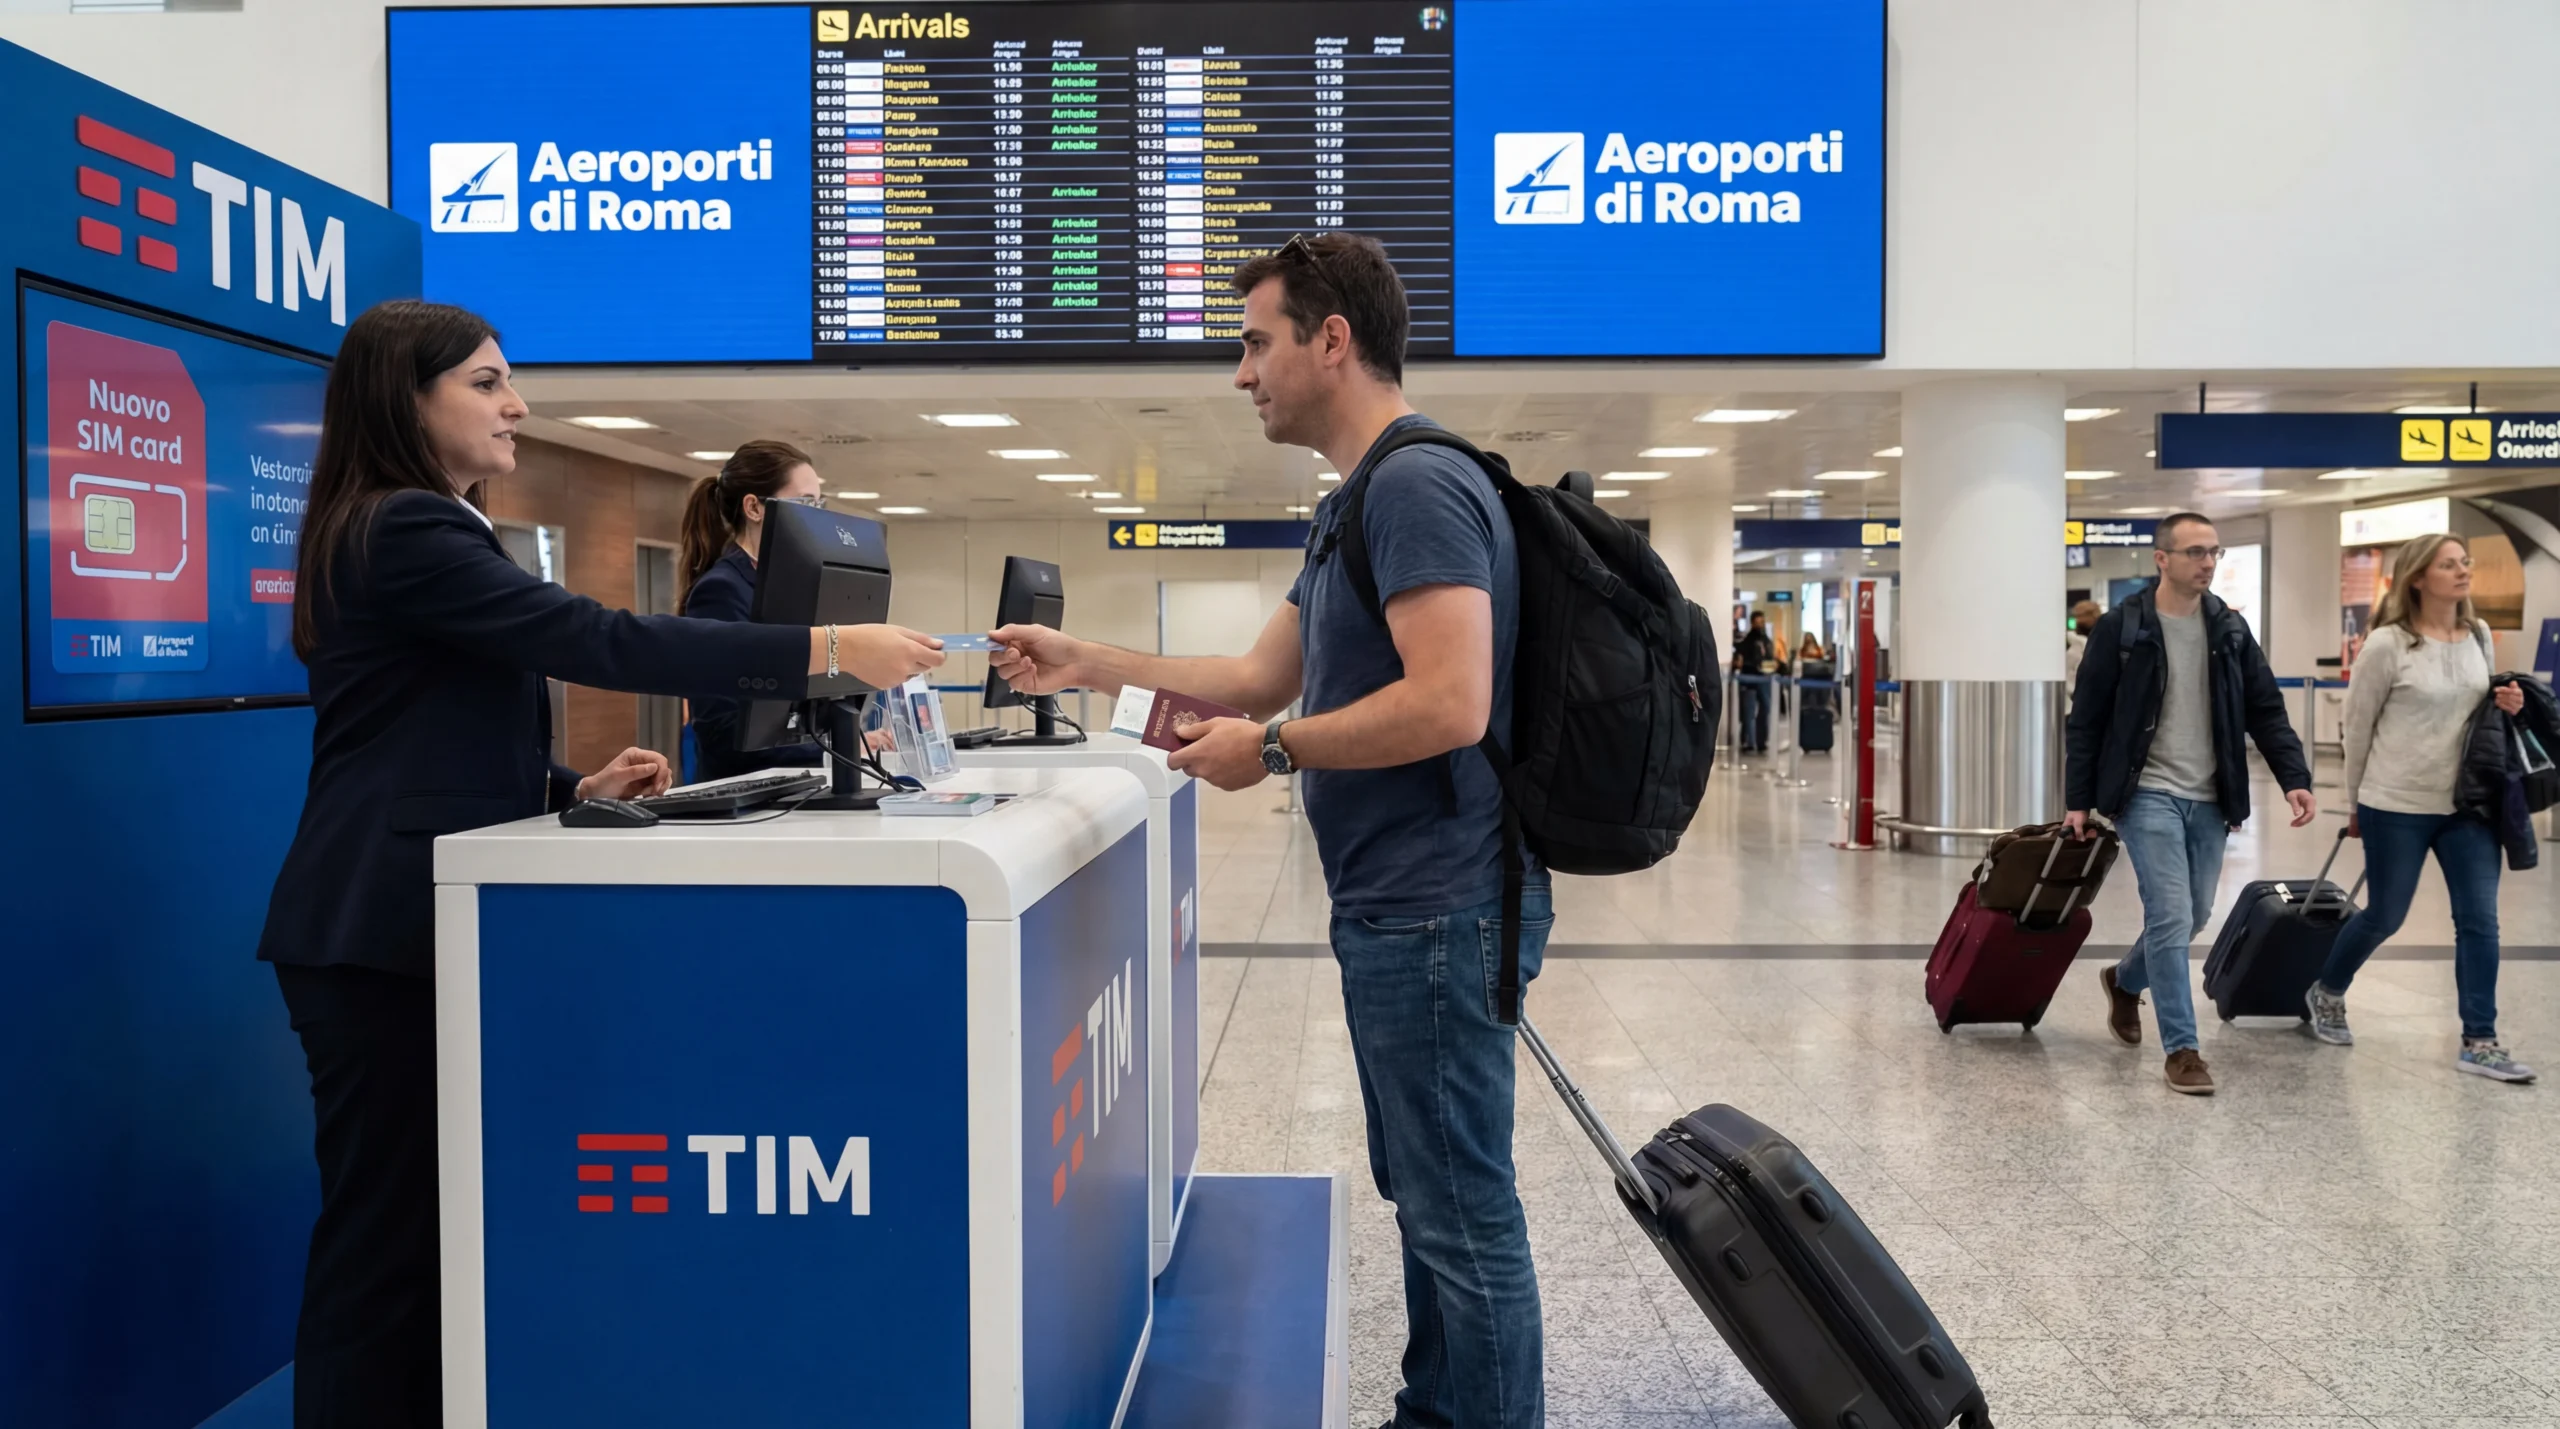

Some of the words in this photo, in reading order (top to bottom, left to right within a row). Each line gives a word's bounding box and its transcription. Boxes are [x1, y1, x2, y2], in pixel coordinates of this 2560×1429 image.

[854, 12, 970, 39] Arrivals
[529, 139, 772, 191] Aeroporti
[1594, 130, 1843, 183] Aeroporti
[529, 189, 576, 232] di
[588, 190, 731, 231] Roma
[1594, 181, 1643, 223] di
[1655, 182, 1801, 223] Roma
[192, 161, 346, 327] TIM
[89, 378, 170, 423] Nuovo
[78, 419, 123, 455] SIM
[130, 435, 182, 465] card
[90, 635, 121, 657] TIM
[1180, 887, 1193, 952] TIM
[1087, 956, 1133, 1139] TIM
[687, 1134, 871, 1216] TIM
